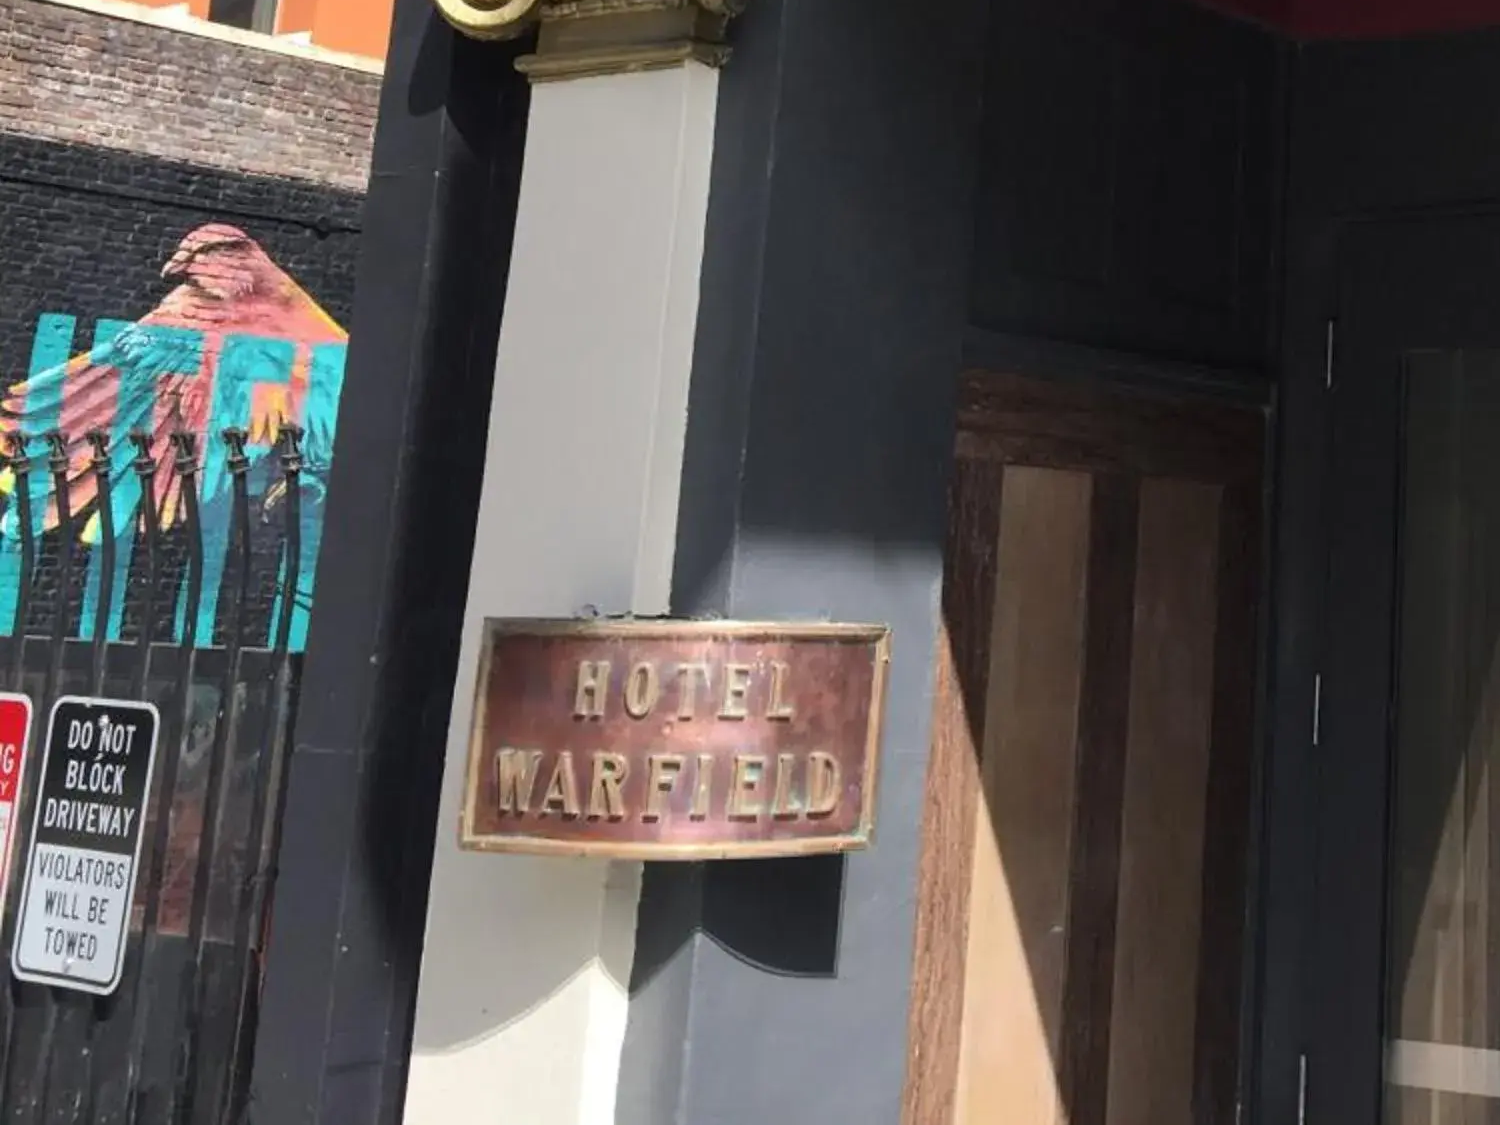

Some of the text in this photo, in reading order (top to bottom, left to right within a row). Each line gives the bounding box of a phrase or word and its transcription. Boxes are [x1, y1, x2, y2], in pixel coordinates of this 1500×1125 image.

[573, 660, 793, 722] HOTEL
[67, 719, 136, 755] DO NOT
[64, 759, 126, 796] BLOCK
[493, 746, 842, 824] WARFIELD
[43, 797, 135, 839] DRIVEWAY
[38, 851, 126, 891] VIOLATORS
[44, 889, 109, 926] WILL BE
[44, 926, 98, 962] TOWED
